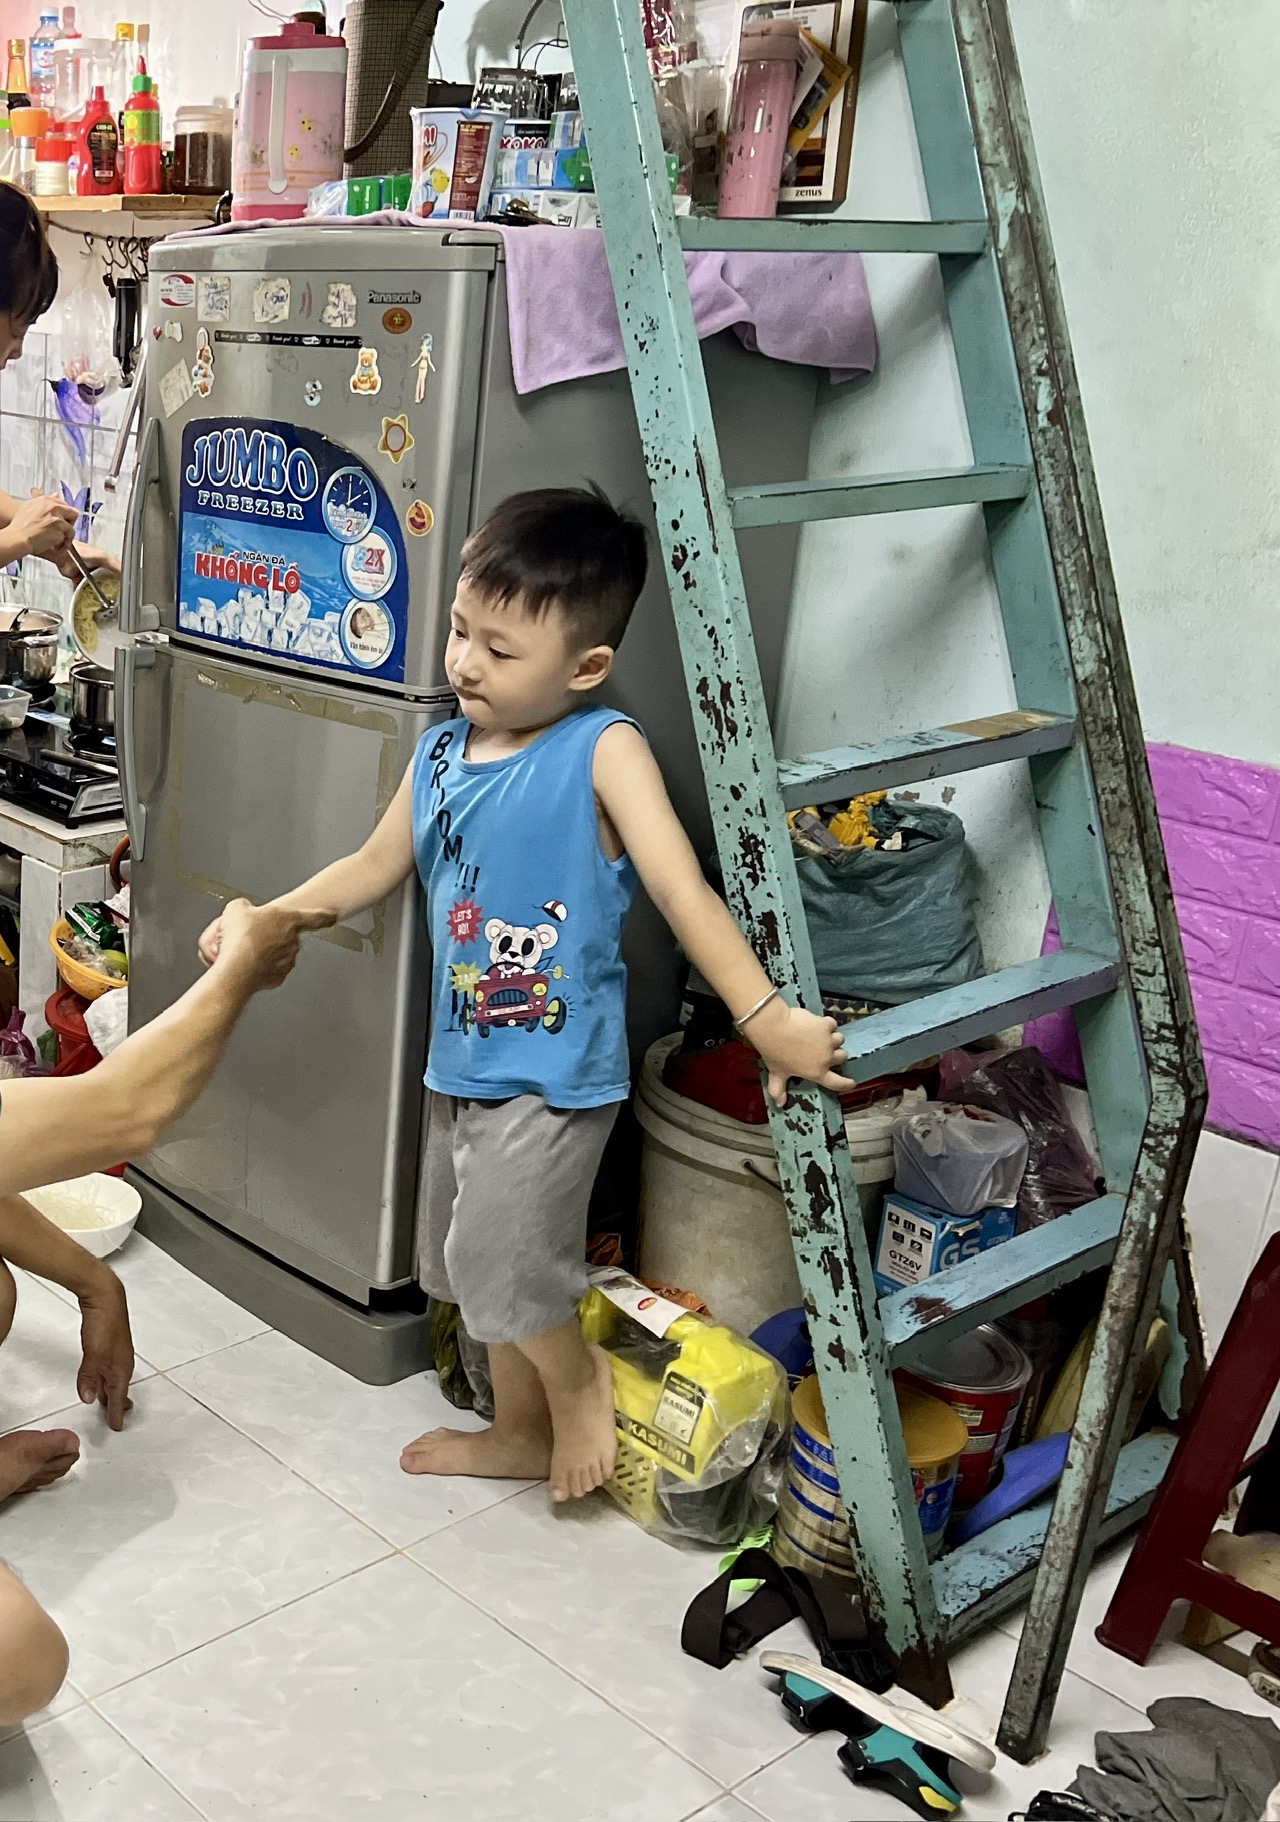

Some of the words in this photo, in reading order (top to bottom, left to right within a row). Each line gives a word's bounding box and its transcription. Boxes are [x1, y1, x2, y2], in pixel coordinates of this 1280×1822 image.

[795, 188, 822, 197] zenus
[368, 290, 421, 304] Panasonic
[186, 428, 319, 502] JUMBO
[198, 490, 305, 521] FREEZER
[346, 518, 354, 532] 2
[365, 547, 386, 568] 2X
[889, 1249, 922, 1272] GTZ6V
[939, 1237, 981, 1272] GS
[664, 1395, 696, 1418] KASUMI
[628, 1420, 687, 1466] KASUMI
